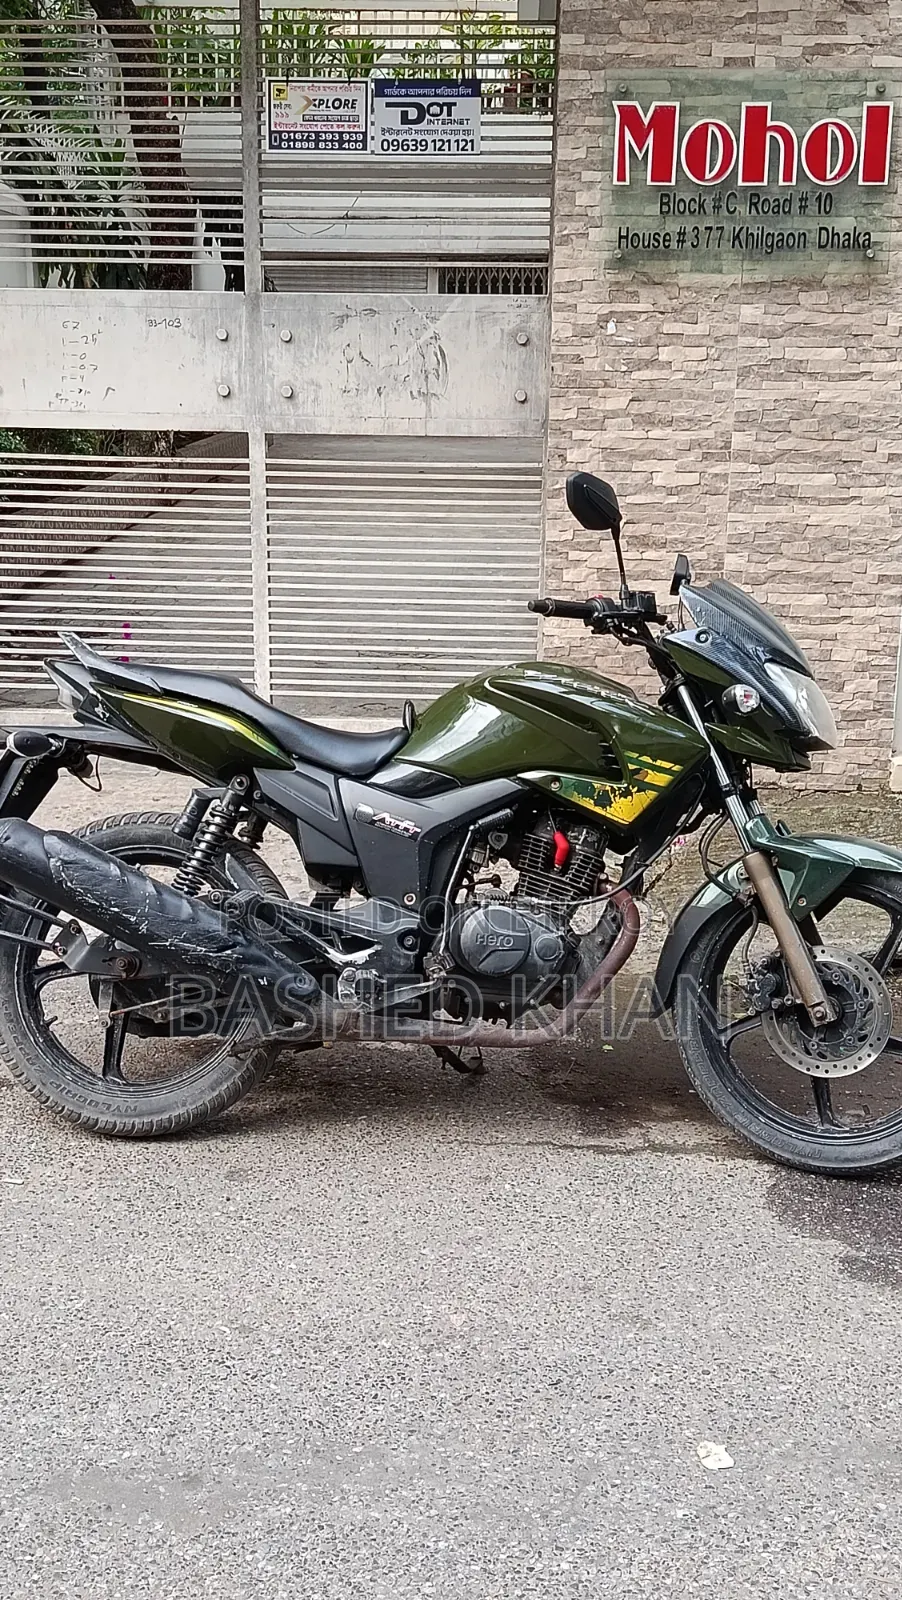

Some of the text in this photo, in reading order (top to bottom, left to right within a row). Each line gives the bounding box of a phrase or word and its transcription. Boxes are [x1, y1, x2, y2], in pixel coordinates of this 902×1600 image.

[384, 85, 472, 96] গার্ডকে আপনার পরিচয় দিন
[385, 101, 457, 126] DOT
[282, 132, 316, 140] 01673
[342, 133, 363, 141] 939
[381, 127, 413, 137] ইন্টারনেট
[414, 128, 439, 136] সংযোগ
[380, 139, 429, 152] 09639
[612, 100, 894, 187] Mohol
[659, 192, 706, 215] Block
[748, 192, 792, 215] Road
[815, 192, 833, 214] 10
[617, 226, 672, 249] House
[731, 226, 807, 254] Khilgaon
[817, 226, 872, 250] Dhaka
[475, 933, 514, 948] Hero
